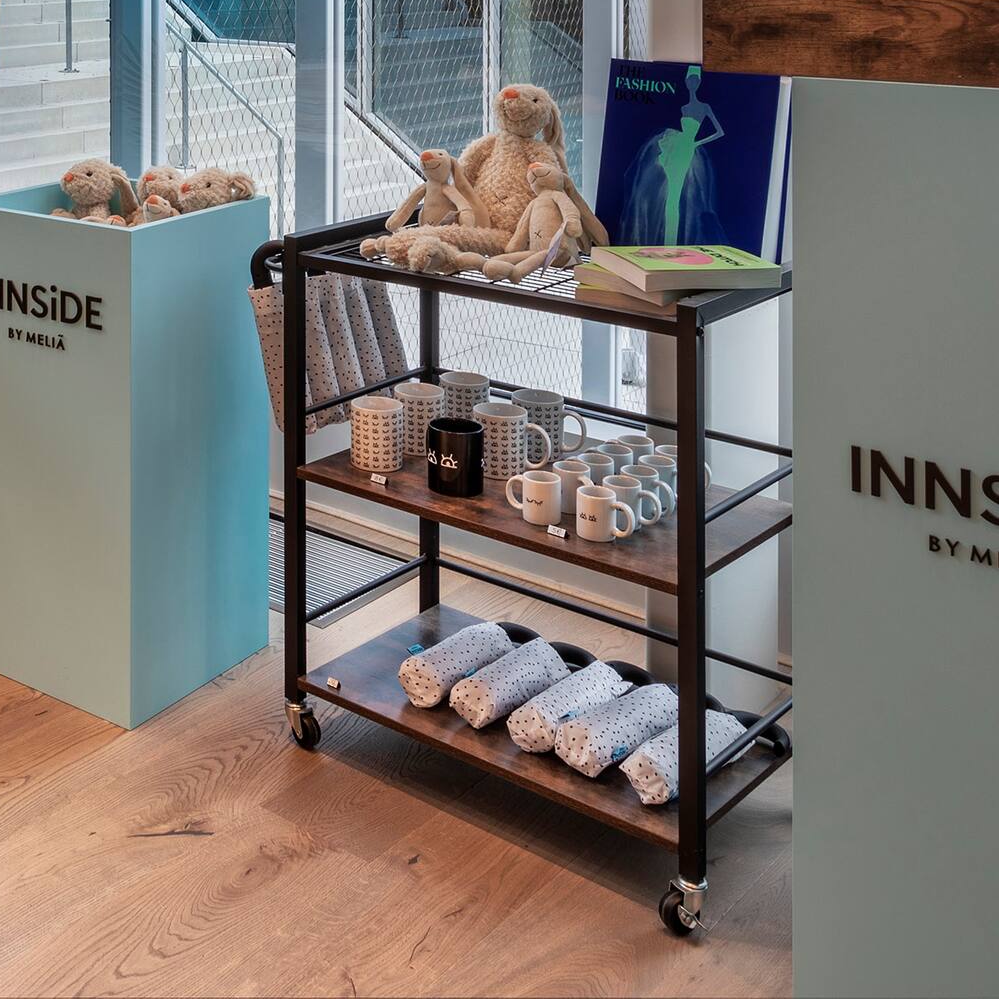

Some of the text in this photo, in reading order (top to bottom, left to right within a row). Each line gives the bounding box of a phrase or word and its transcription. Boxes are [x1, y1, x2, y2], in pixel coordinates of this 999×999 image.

[614, 77, 677, 95] FASHION
[8, 327, 23, 341] BY
[928, 534, 999, 569] BY M
